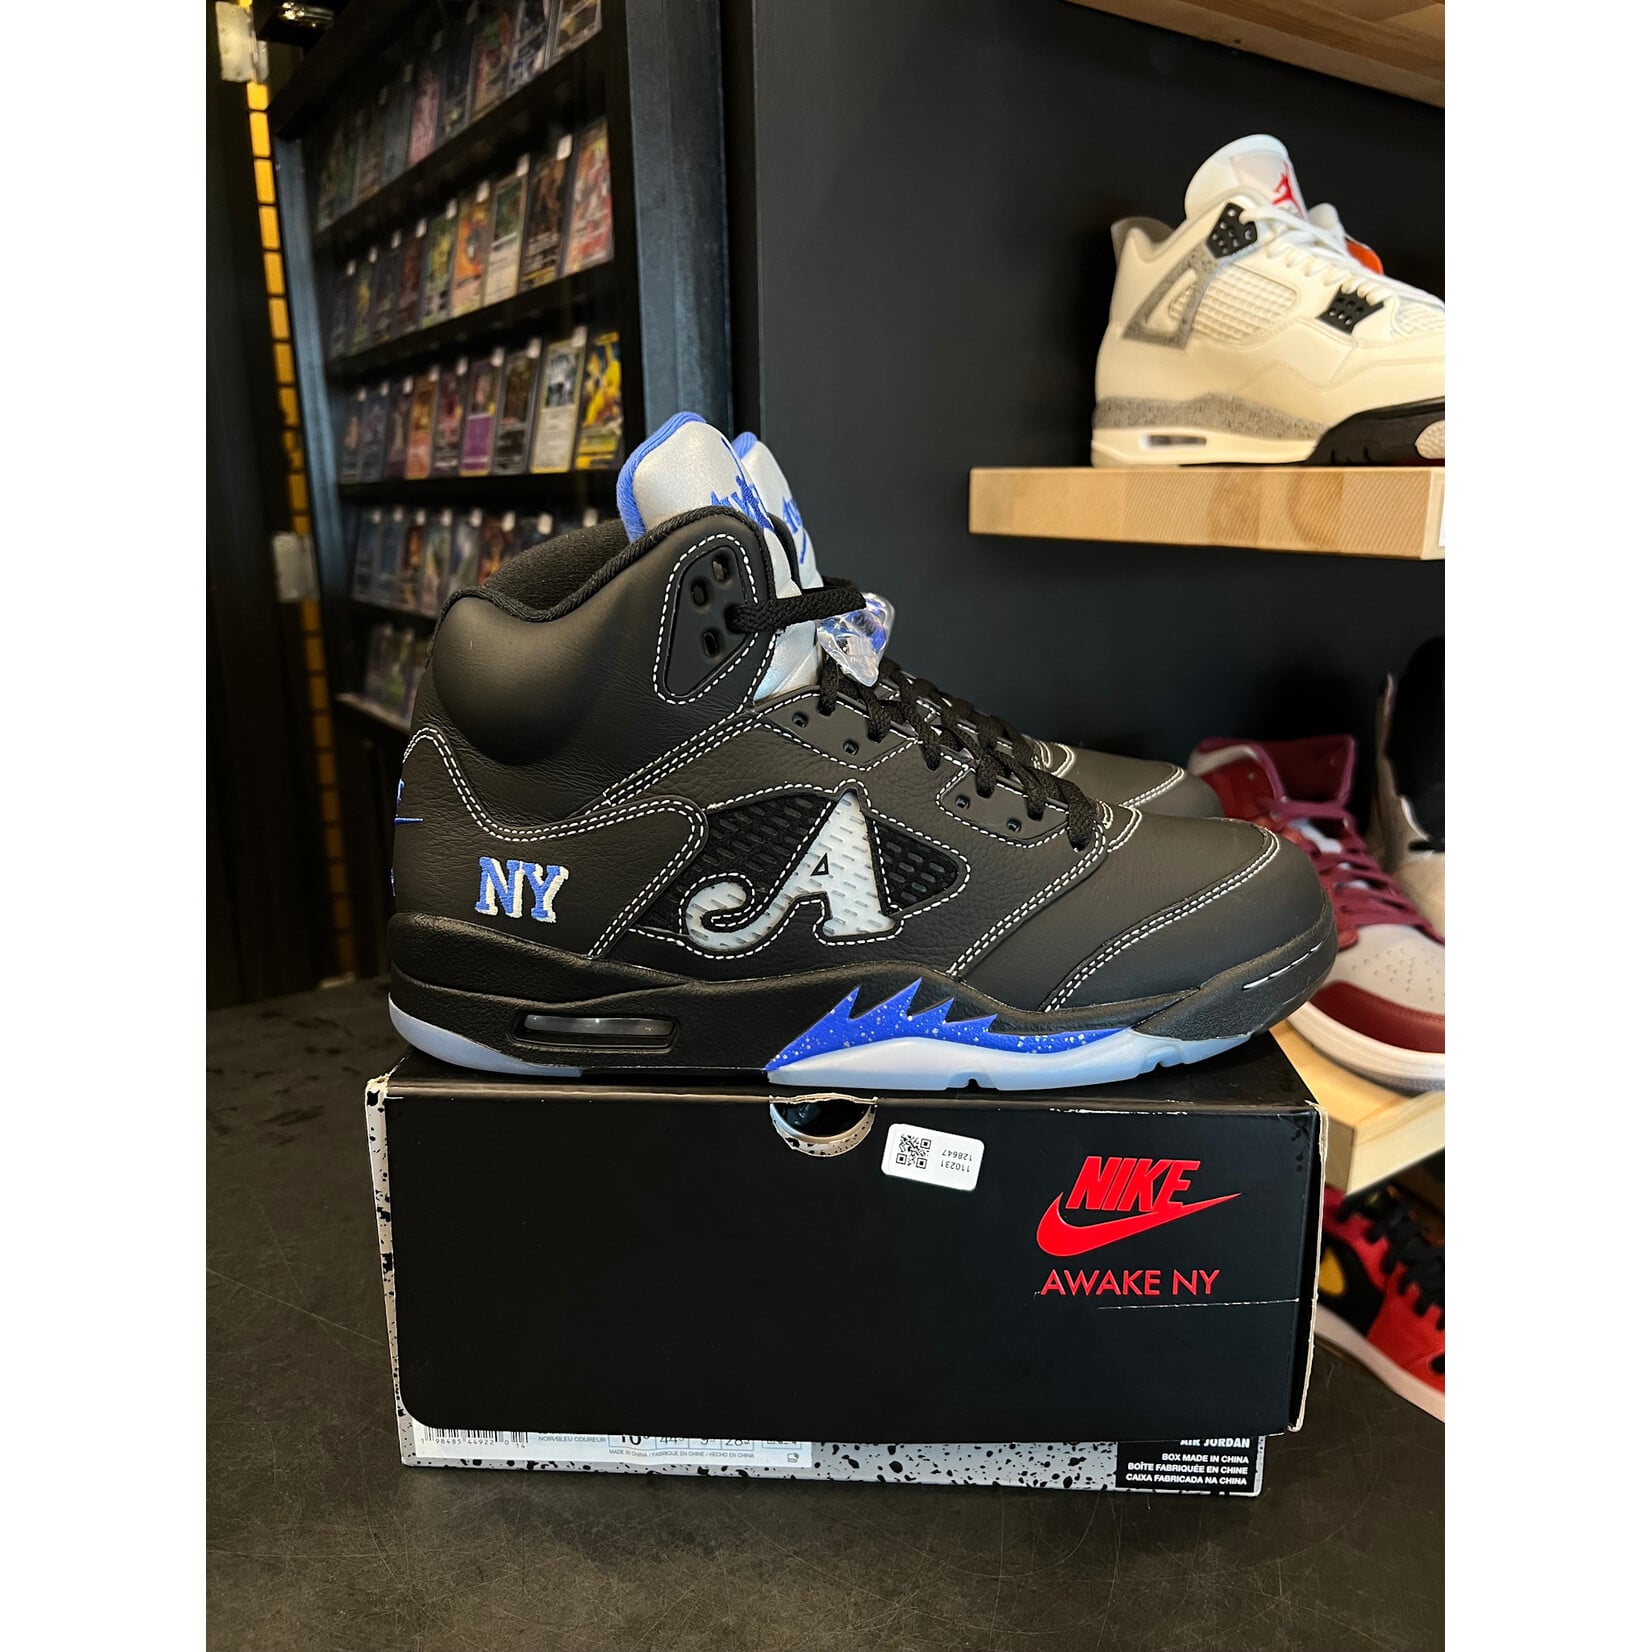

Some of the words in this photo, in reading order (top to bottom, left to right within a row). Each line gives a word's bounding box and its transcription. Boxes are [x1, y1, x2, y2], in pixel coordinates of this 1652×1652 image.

[474, 856, 569, 923] NY
[942, 1149, 972, 1161] 128647
[940, 1160, 970, 1172] 110231
[1065, 1155, 1201, 1213] NIKE
[1040, 1268, 1161, 1296] AWAKE
[1172, 1269, 1220, 1296] NY
[1203, 1437, 1251, 1449] JORDAN
[1161, 1453, 1181, 1462] BOX
[1182, 1453, 1209, 1463] MADE
[1209, 1454, 1220, 1463] IN
[1221, 1455, 1249, 1464] CHINA
[1127, 1461, 1154, 1471] BOÎTE
[1155, 1463, 1205, 1473] FABRIQUÉE
[1206, 1465, 1219, 1474] EN
[1220, 1466, 1248, 1475] CHINE
[1125, 1473, 1153, 1482] CAIXA
[1154, 1474, 1204, 1484] FABRICADA
[1205, 1476, 1218, 1484] NA
[1219, 1476, 1247, 1485] CHINA
